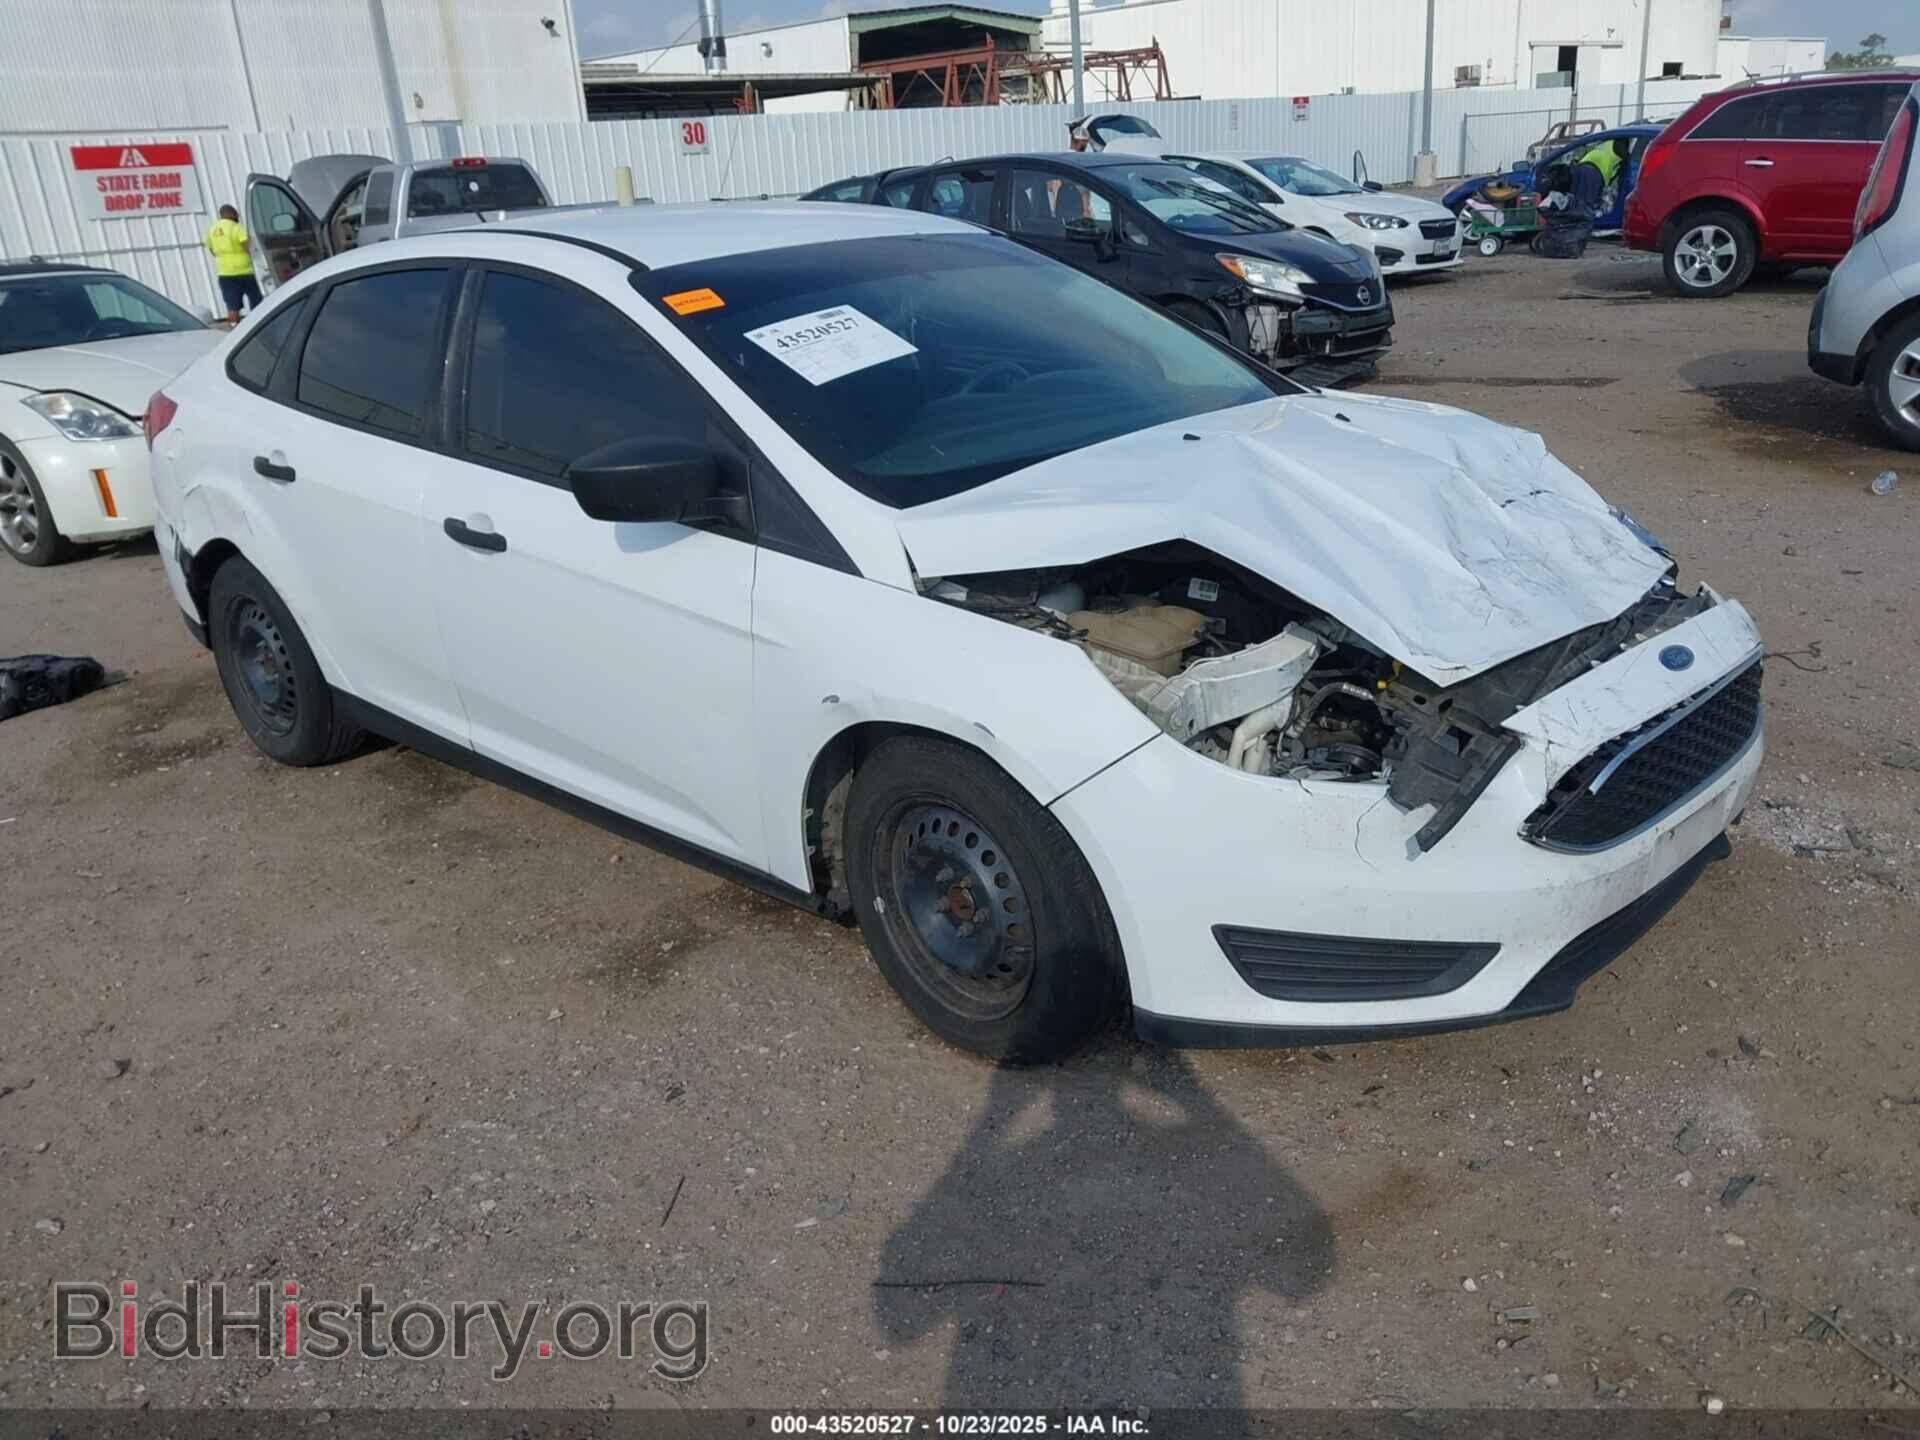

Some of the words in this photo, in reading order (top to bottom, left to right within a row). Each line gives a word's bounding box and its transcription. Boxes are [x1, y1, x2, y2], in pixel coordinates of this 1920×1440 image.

[682, 122, 705, 145] 30
[96, 174, 140, 192] STATE
[143, 172, 182, 190] FARM
[104, 194, 146, 212] DROP
[148, 192, 182, 209] ZONE
[776, 317, 860, 350] 43520527
